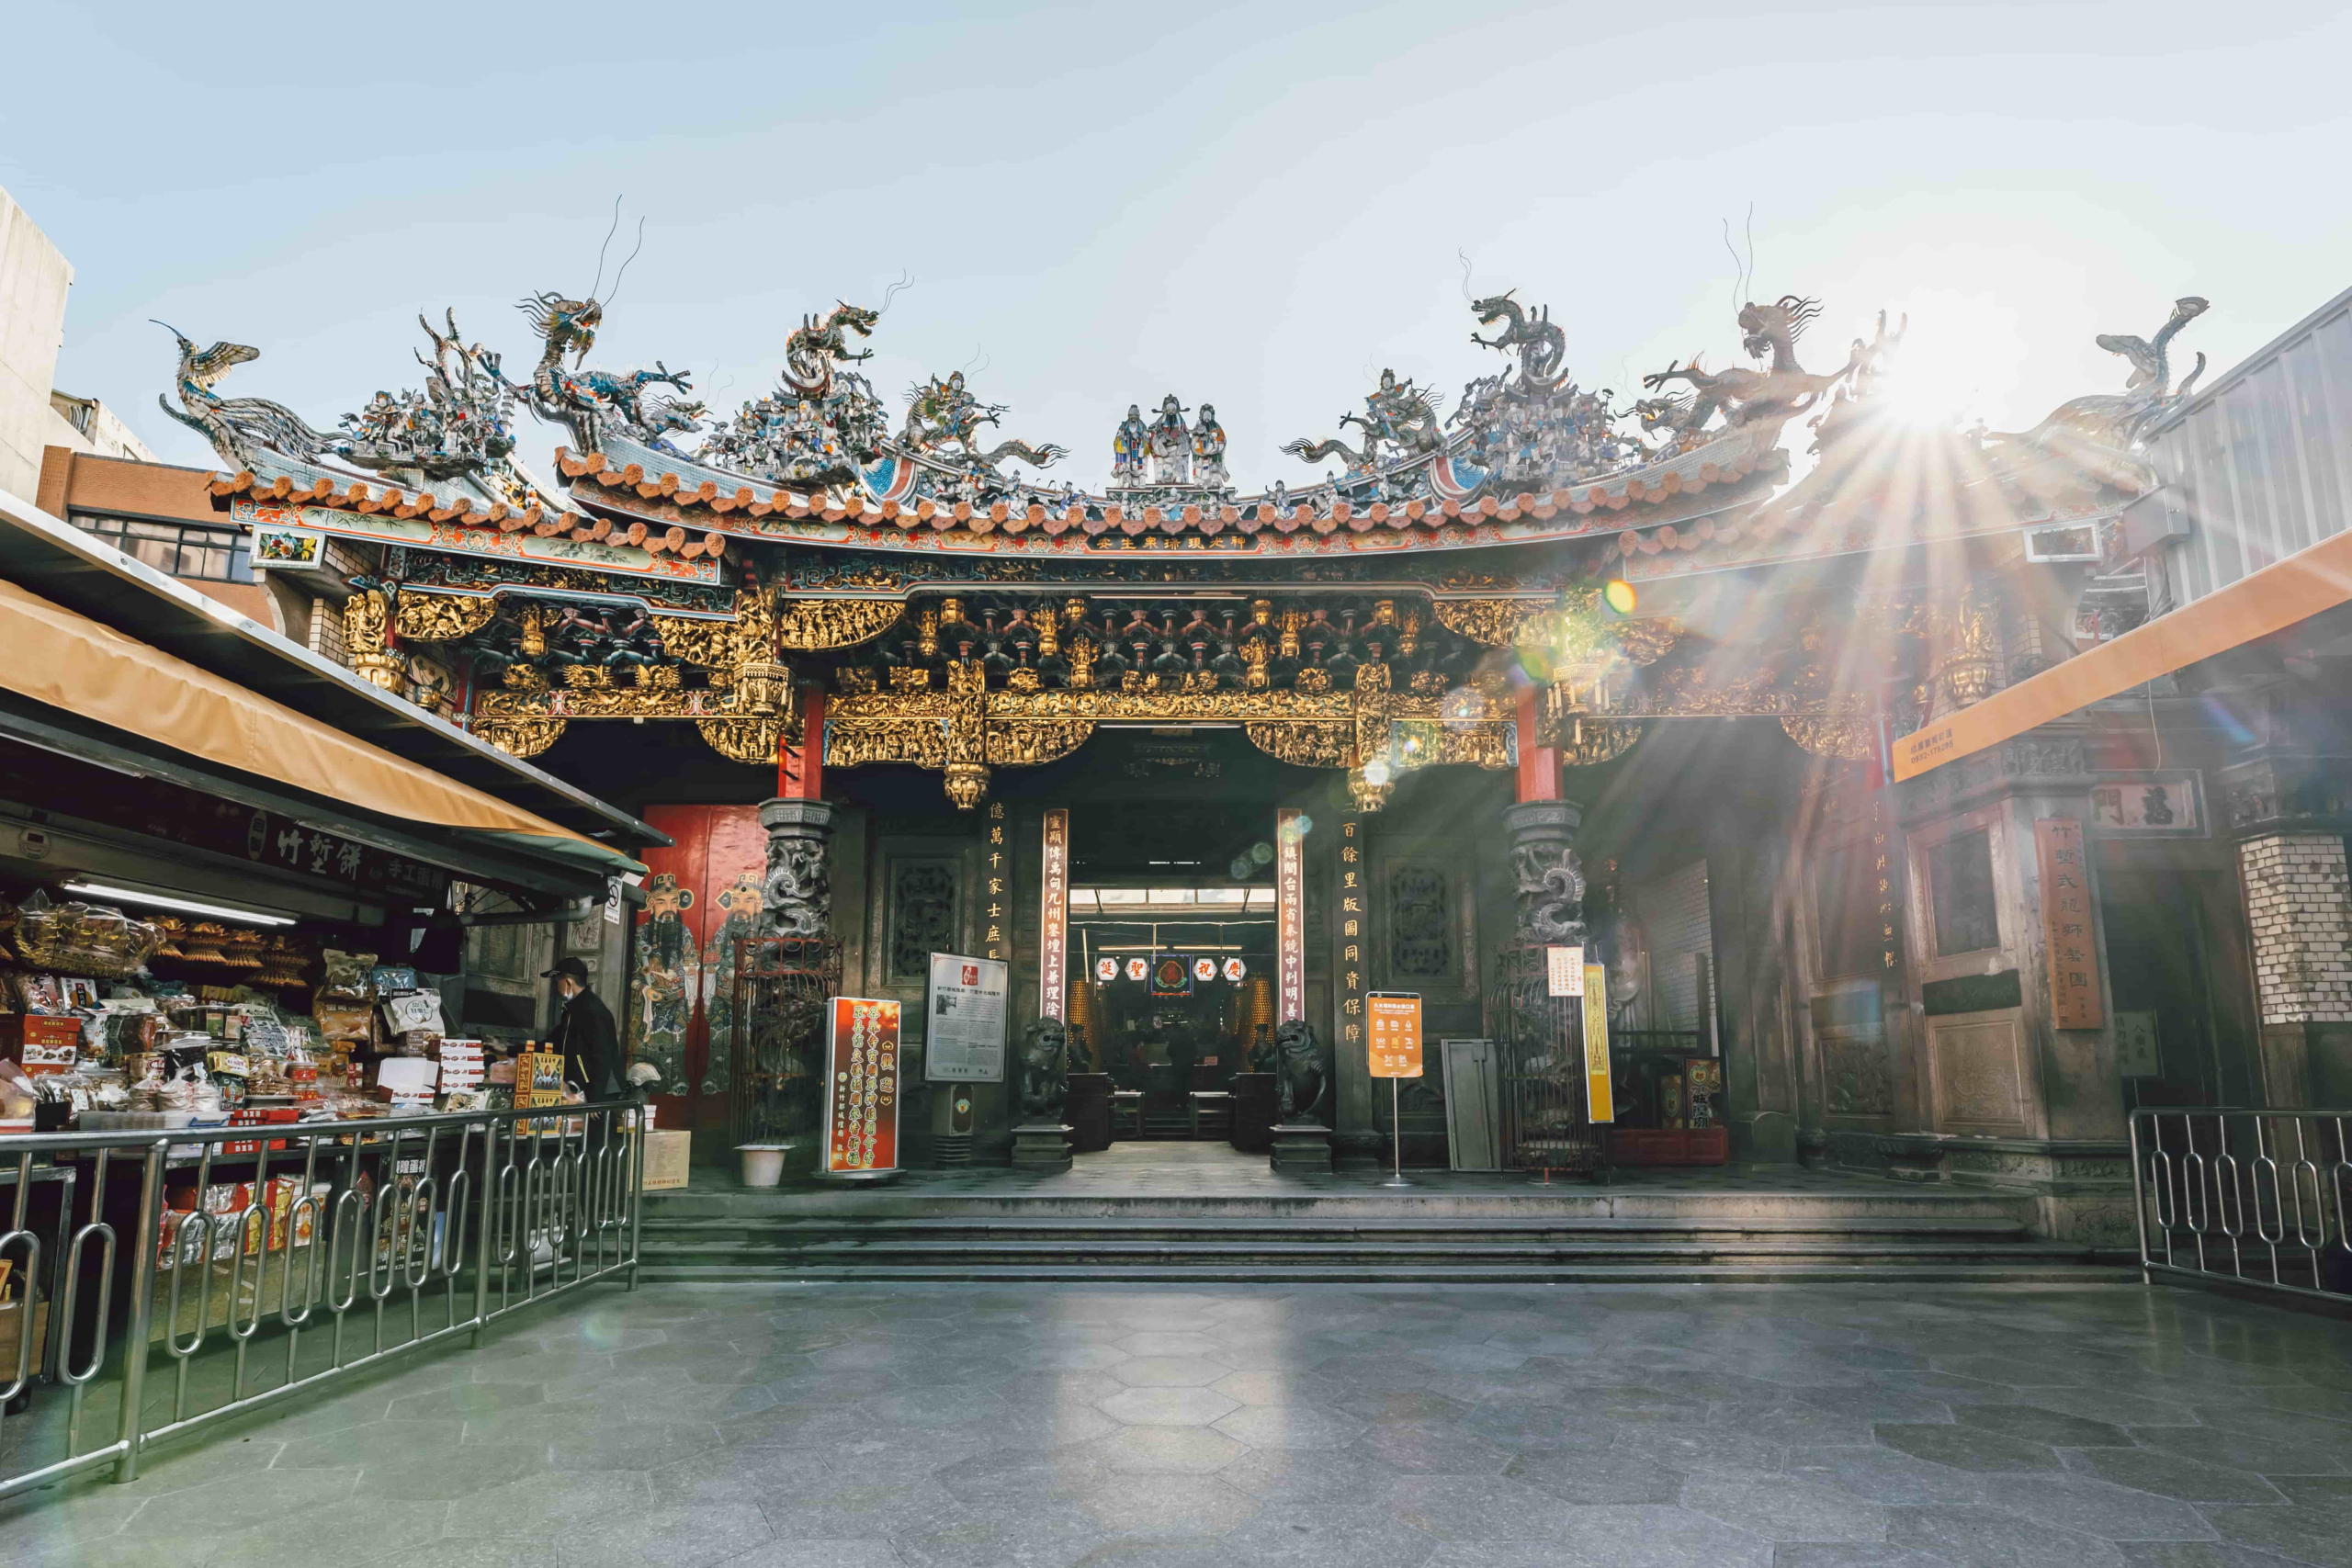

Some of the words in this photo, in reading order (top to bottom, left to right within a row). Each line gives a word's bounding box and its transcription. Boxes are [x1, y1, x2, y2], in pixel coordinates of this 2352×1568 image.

[277, 829, 362, 881] 竹塹餅
[1100, 961, 1114, 976] 誕
[1130, 961, 1144, 977] 聖
[1198, 962, 1212, 977] 祝
[1226, 961, 1241, 977] 慶
[879, 1053, 895, 1093] 歡迎
